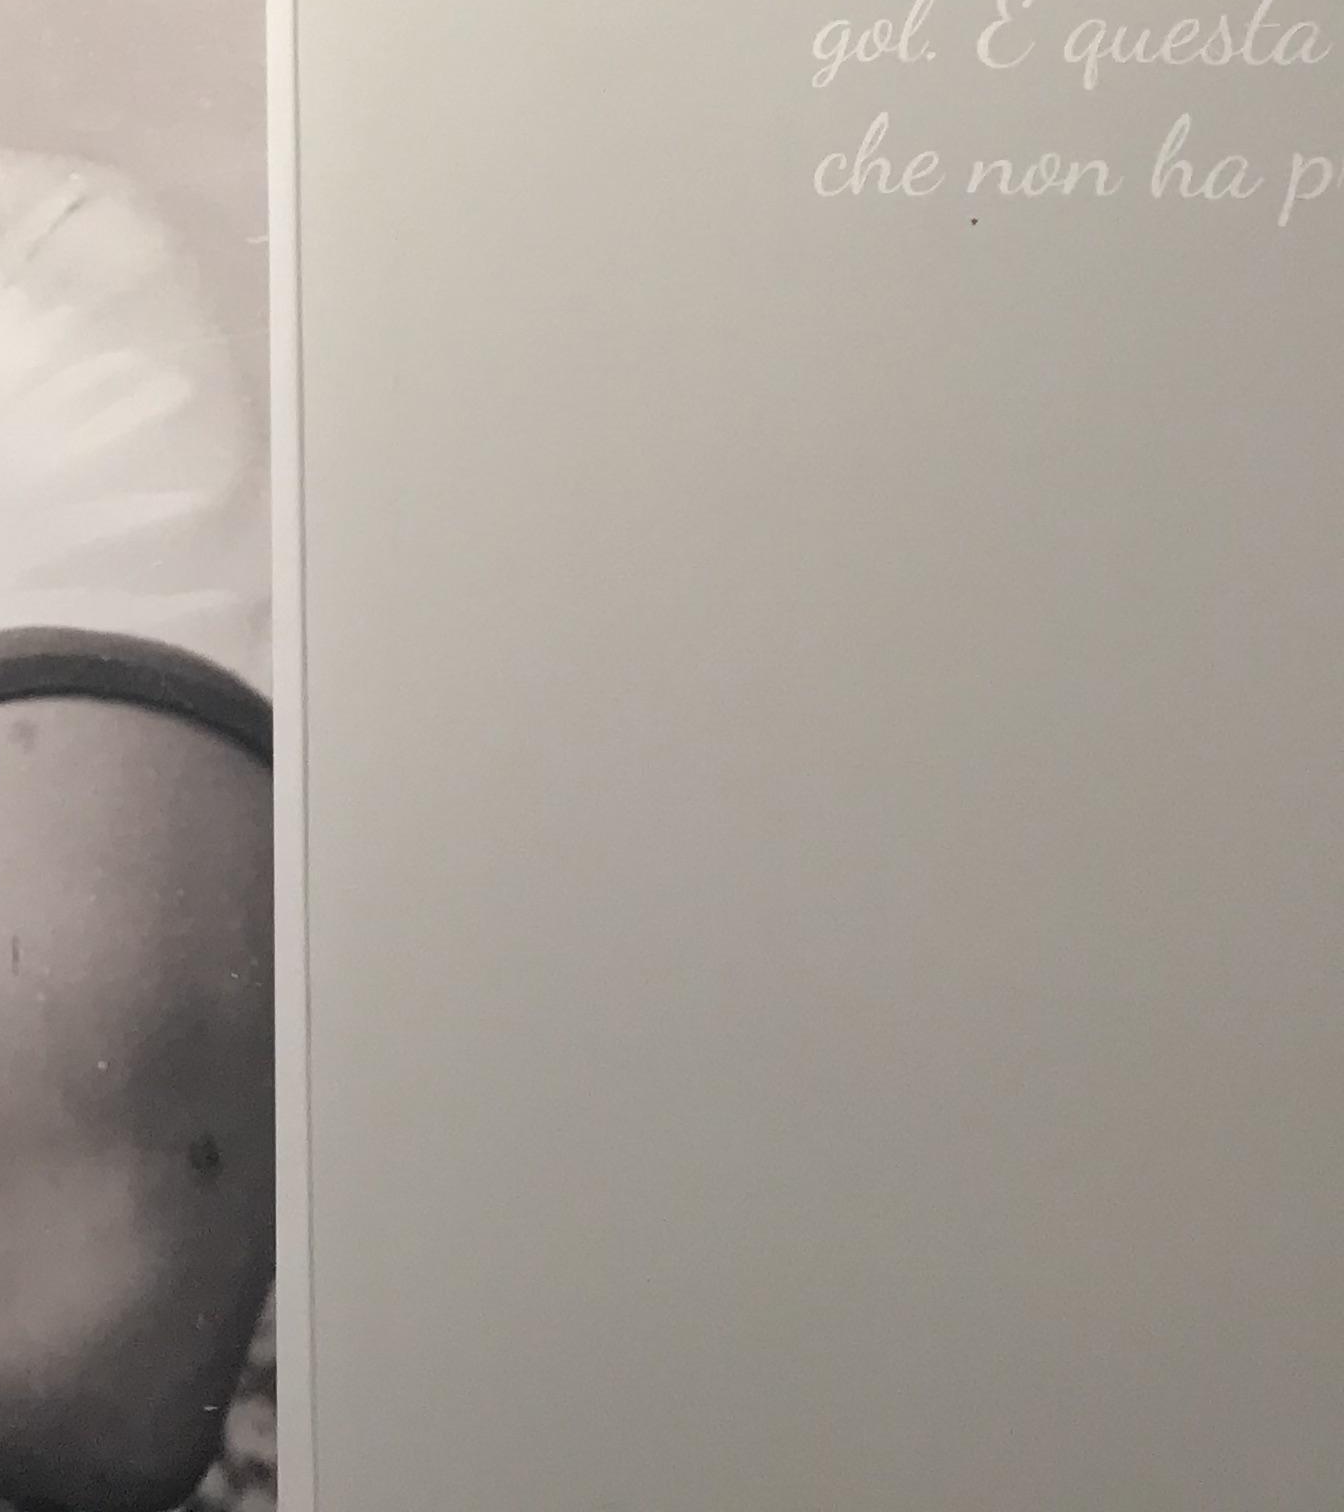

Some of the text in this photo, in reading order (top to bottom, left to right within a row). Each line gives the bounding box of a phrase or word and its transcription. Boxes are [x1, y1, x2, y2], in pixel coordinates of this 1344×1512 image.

[813, 110, 1344, 228] che non ha p
